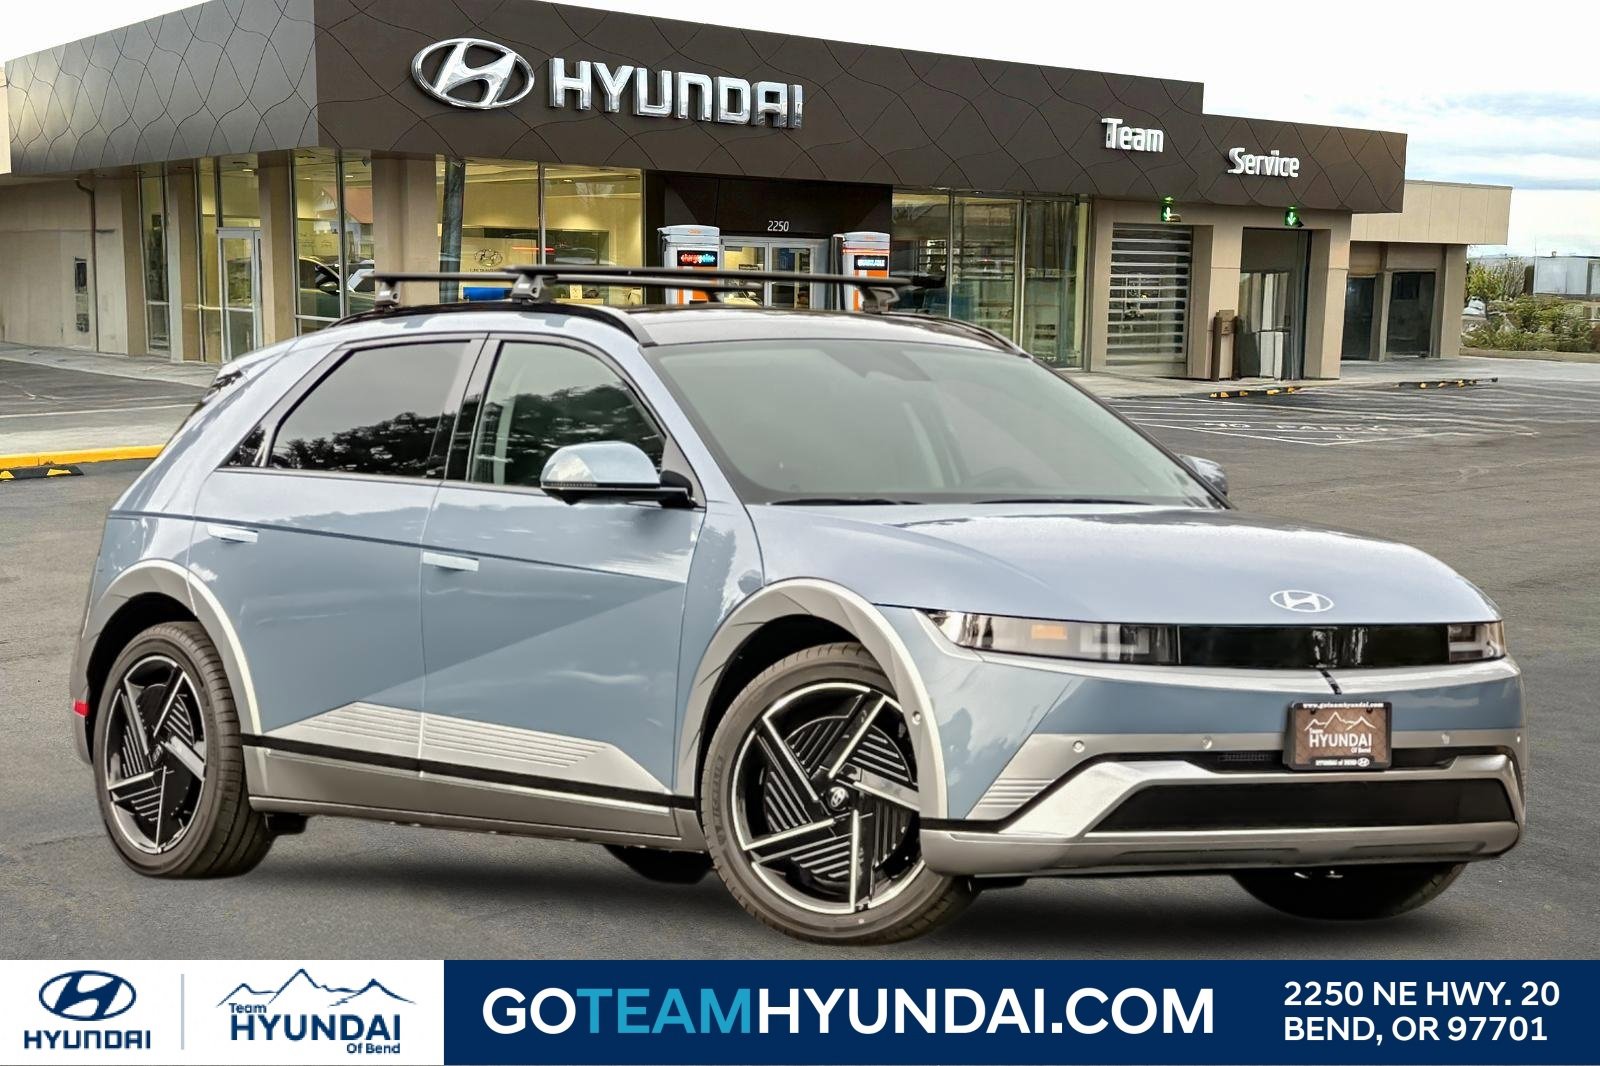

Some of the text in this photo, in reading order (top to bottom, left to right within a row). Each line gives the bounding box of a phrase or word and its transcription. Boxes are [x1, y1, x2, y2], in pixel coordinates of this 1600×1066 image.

[548, 57, 803, 129] HYUNDAI
[1101, 117, 1164, 153] Team
[1227, 147, 1300, 178] Service
[767, 220, 790, 232] 2250
[1309, 733, 1373, 748] HYUNDAI
